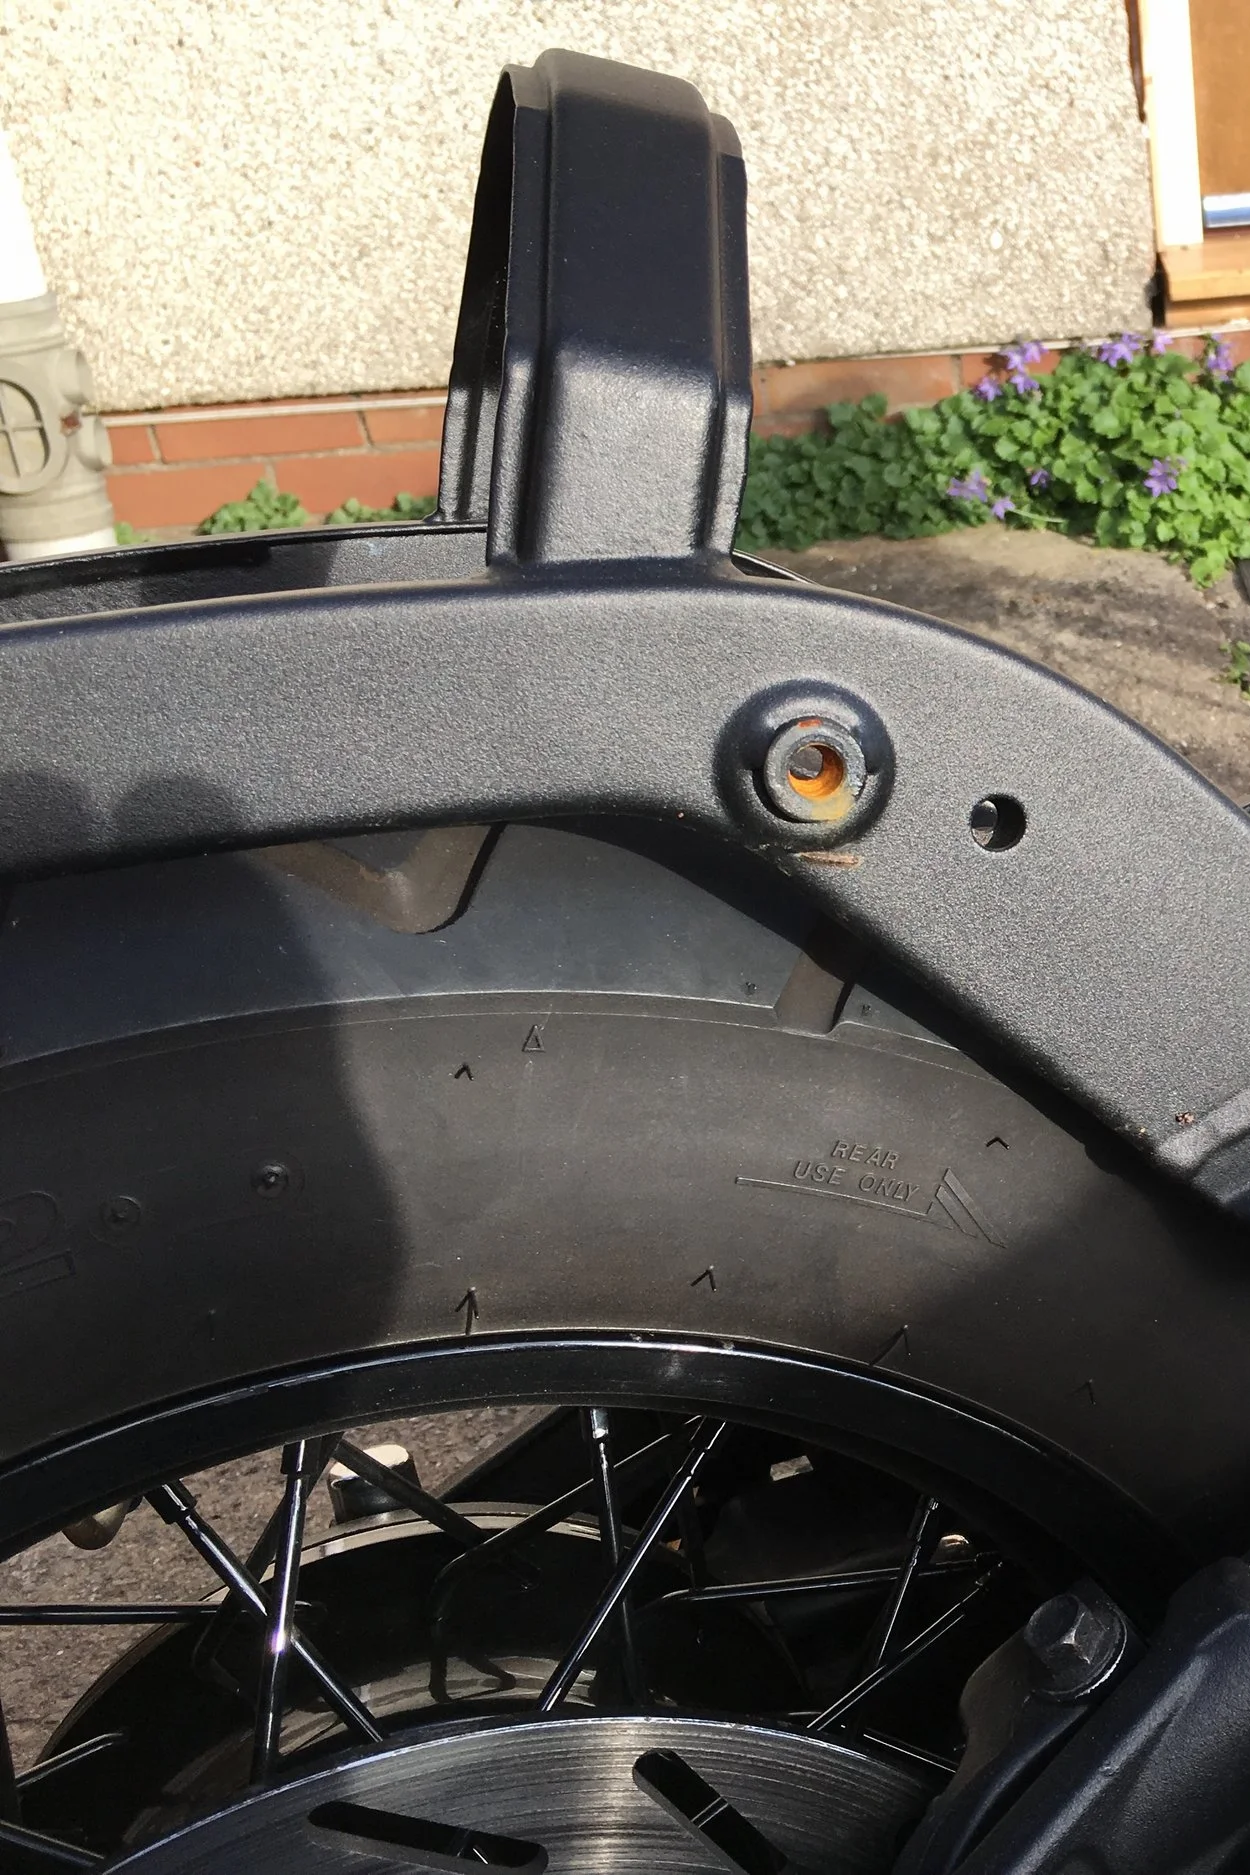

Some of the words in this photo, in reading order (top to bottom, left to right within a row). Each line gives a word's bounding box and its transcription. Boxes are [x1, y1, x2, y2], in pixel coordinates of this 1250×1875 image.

[831, 1139, 902, 1171] REAR
[793, 1160, 847, 1186] USE
[858, 1172, 921, 1203] ONLY
